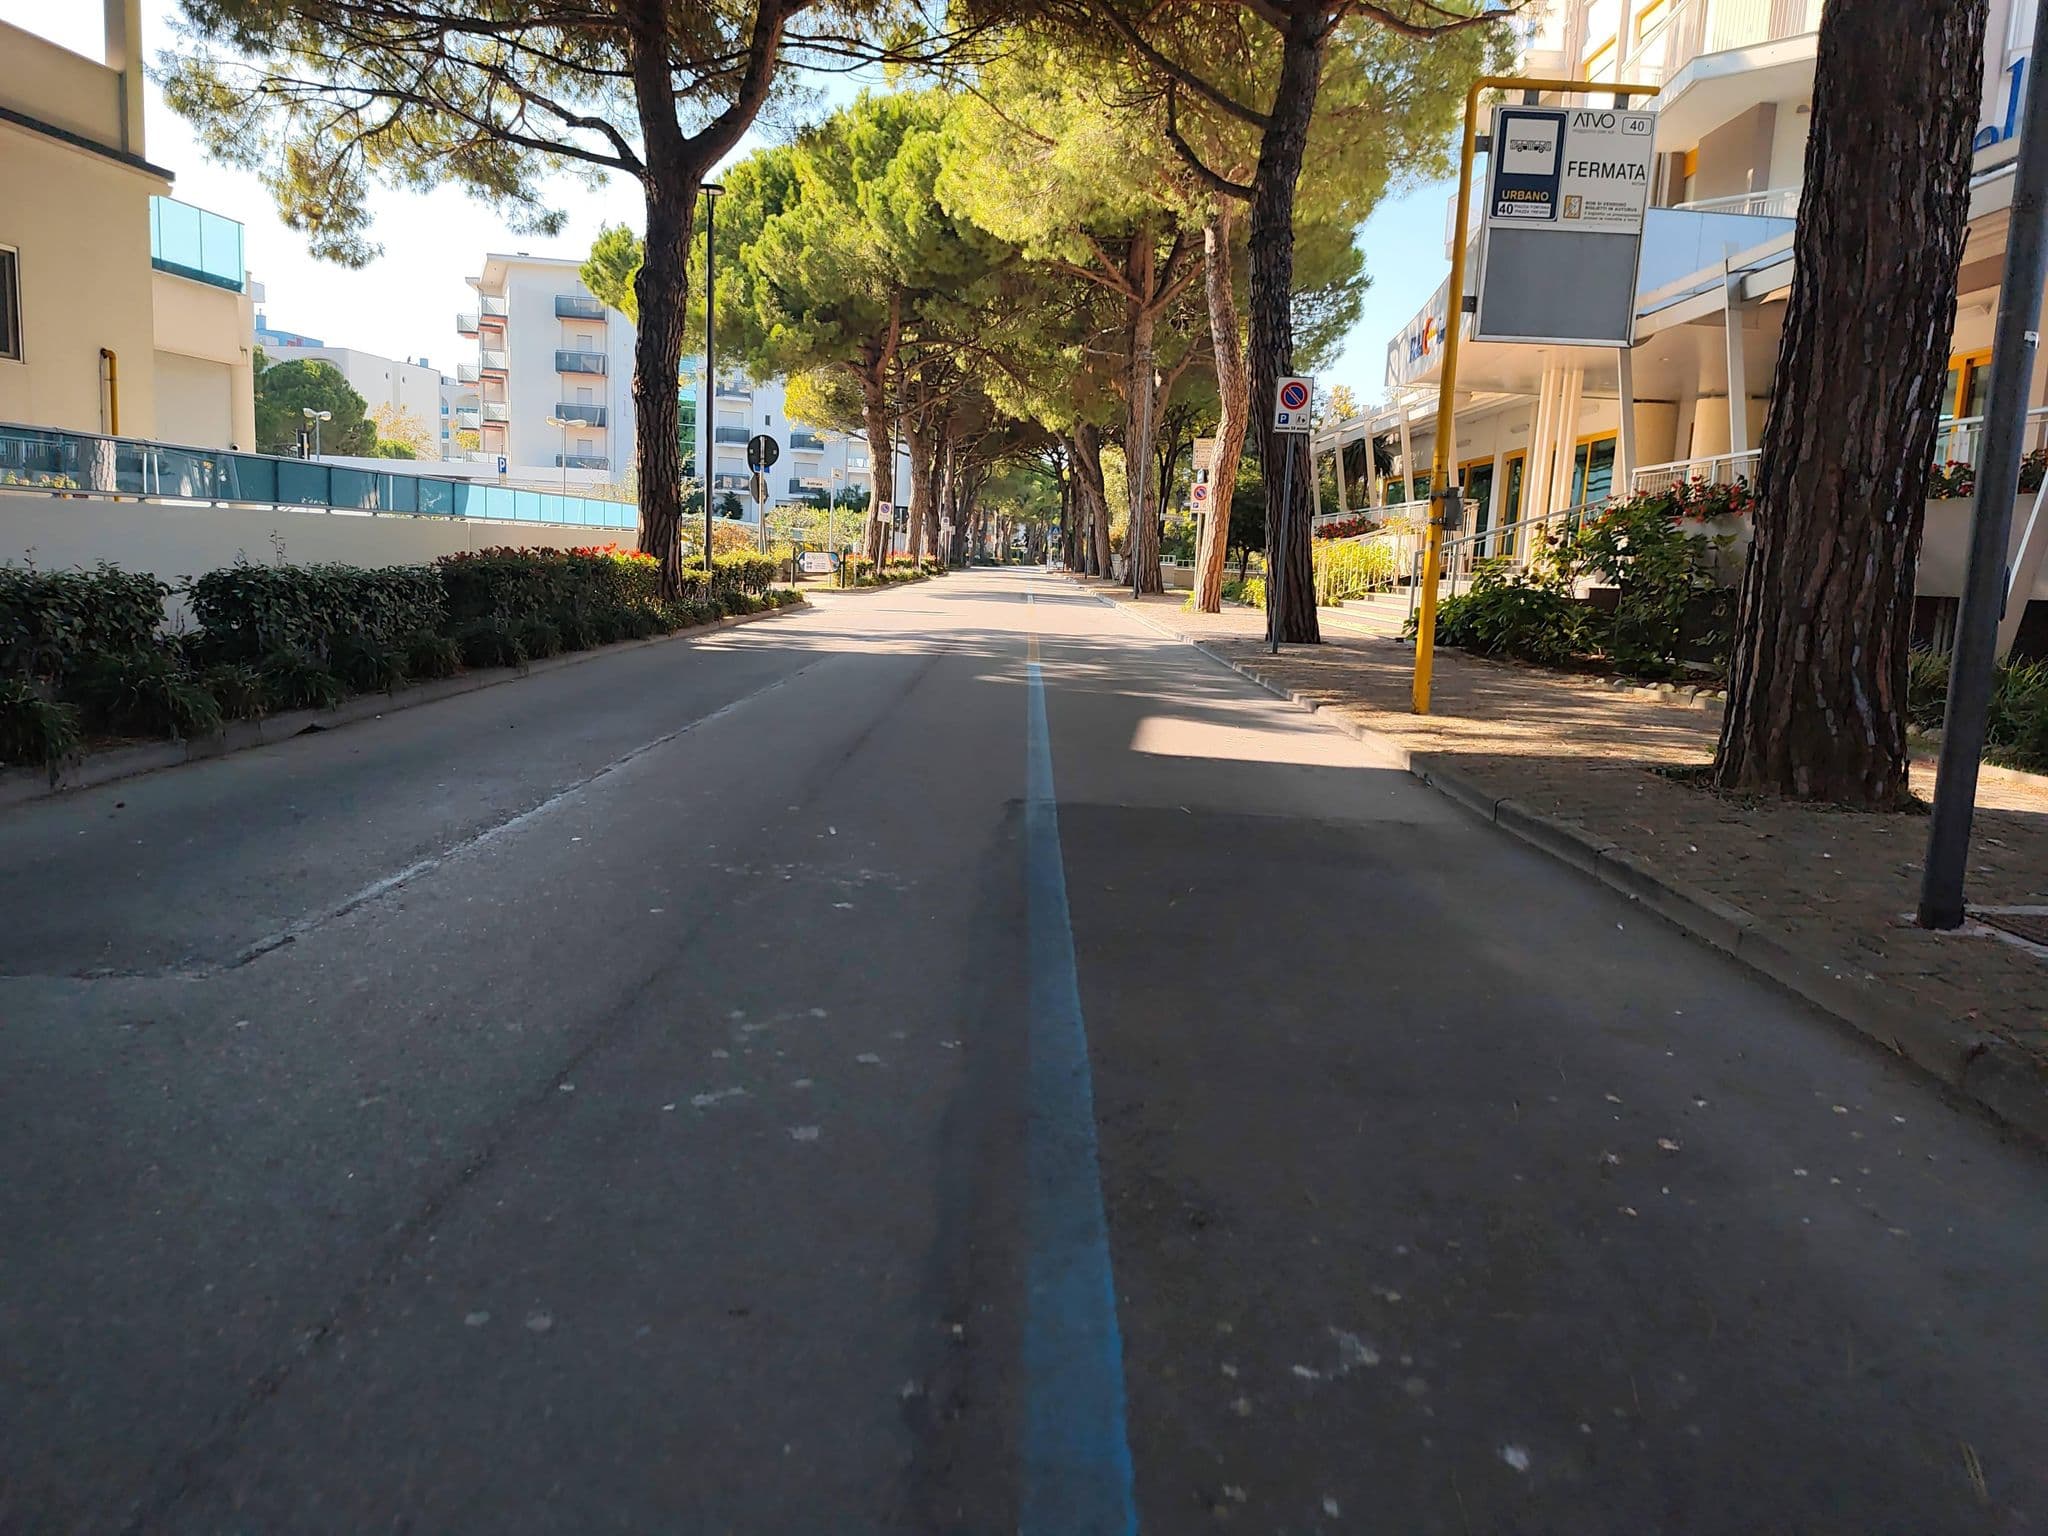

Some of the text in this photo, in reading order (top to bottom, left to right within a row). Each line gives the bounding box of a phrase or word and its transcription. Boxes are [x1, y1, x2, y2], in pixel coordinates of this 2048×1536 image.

[1573, 112, 1616, 128] ATVO
[1630, 120, 1645, 132] 40
[1567, 161, 1646, 180] FERMATA
[1501, 190, 1549, 201] URBANO
[1498, 203, 1514, 215] 40
